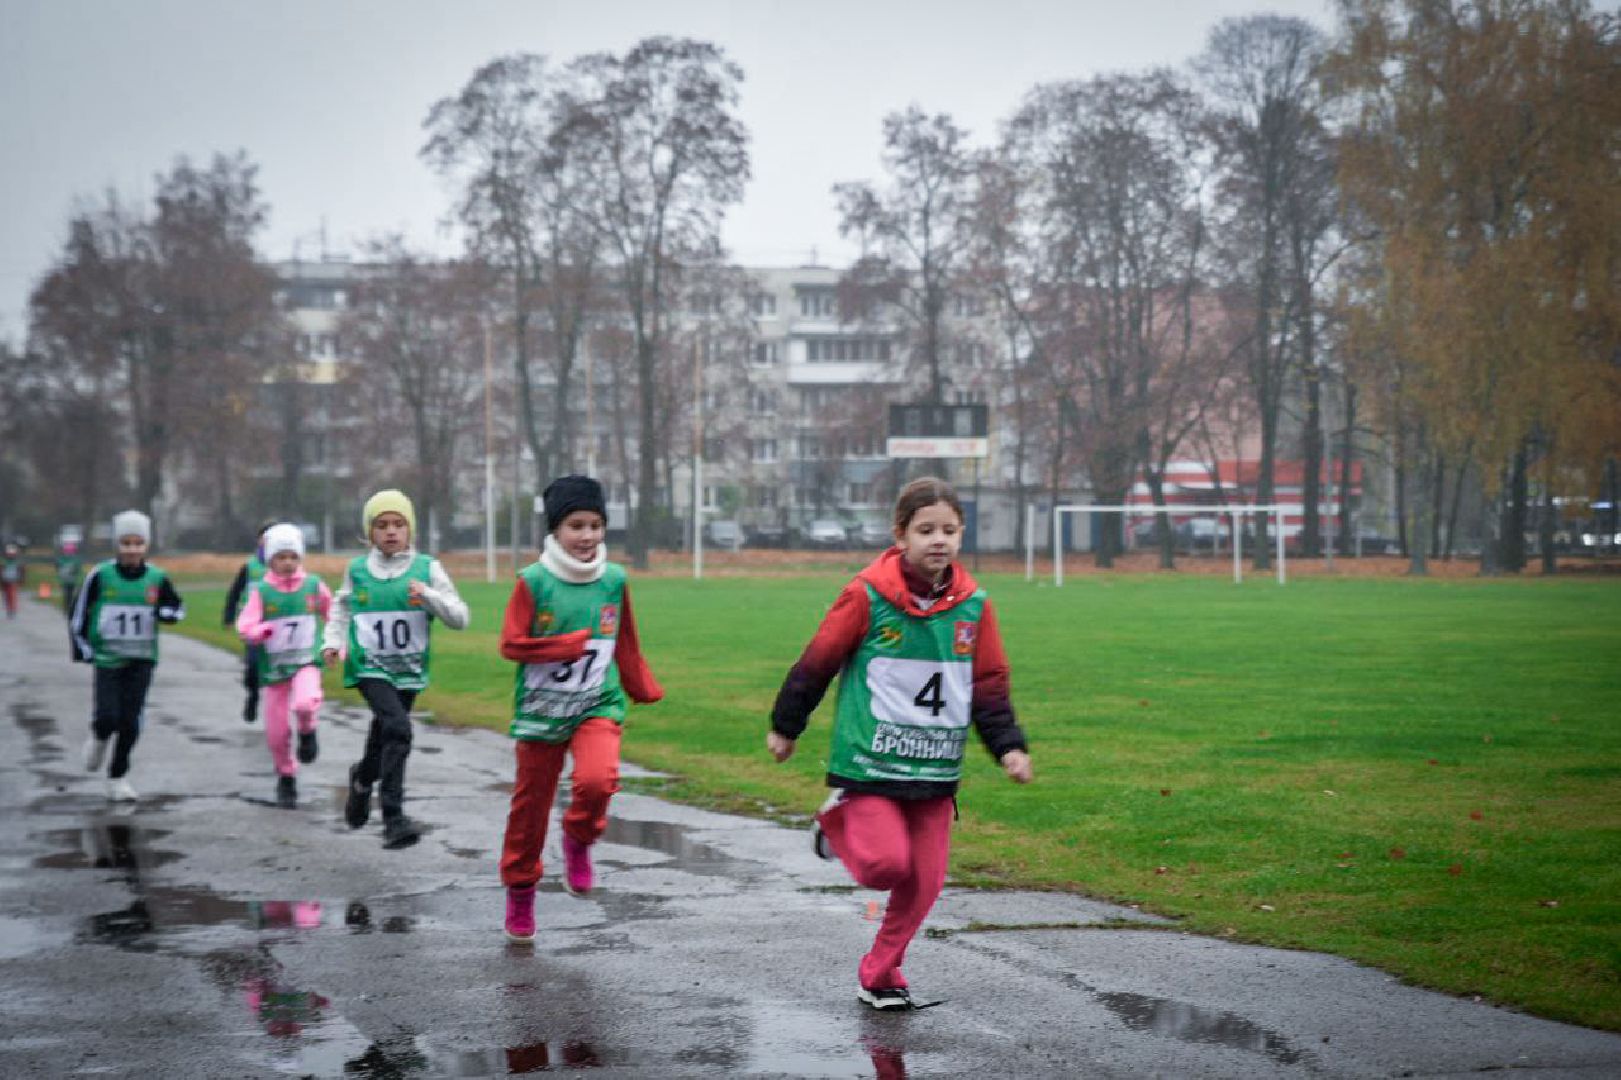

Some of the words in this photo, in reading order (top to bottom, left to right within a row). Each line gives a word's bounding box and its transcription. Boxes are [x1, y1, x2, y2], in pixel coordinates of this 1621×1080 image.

[114, 613, 142, 635] 11
[285, 621, 298, 644] 7
[374, 619, 410, 650] 10
[914, 671, 947, 716] 4
